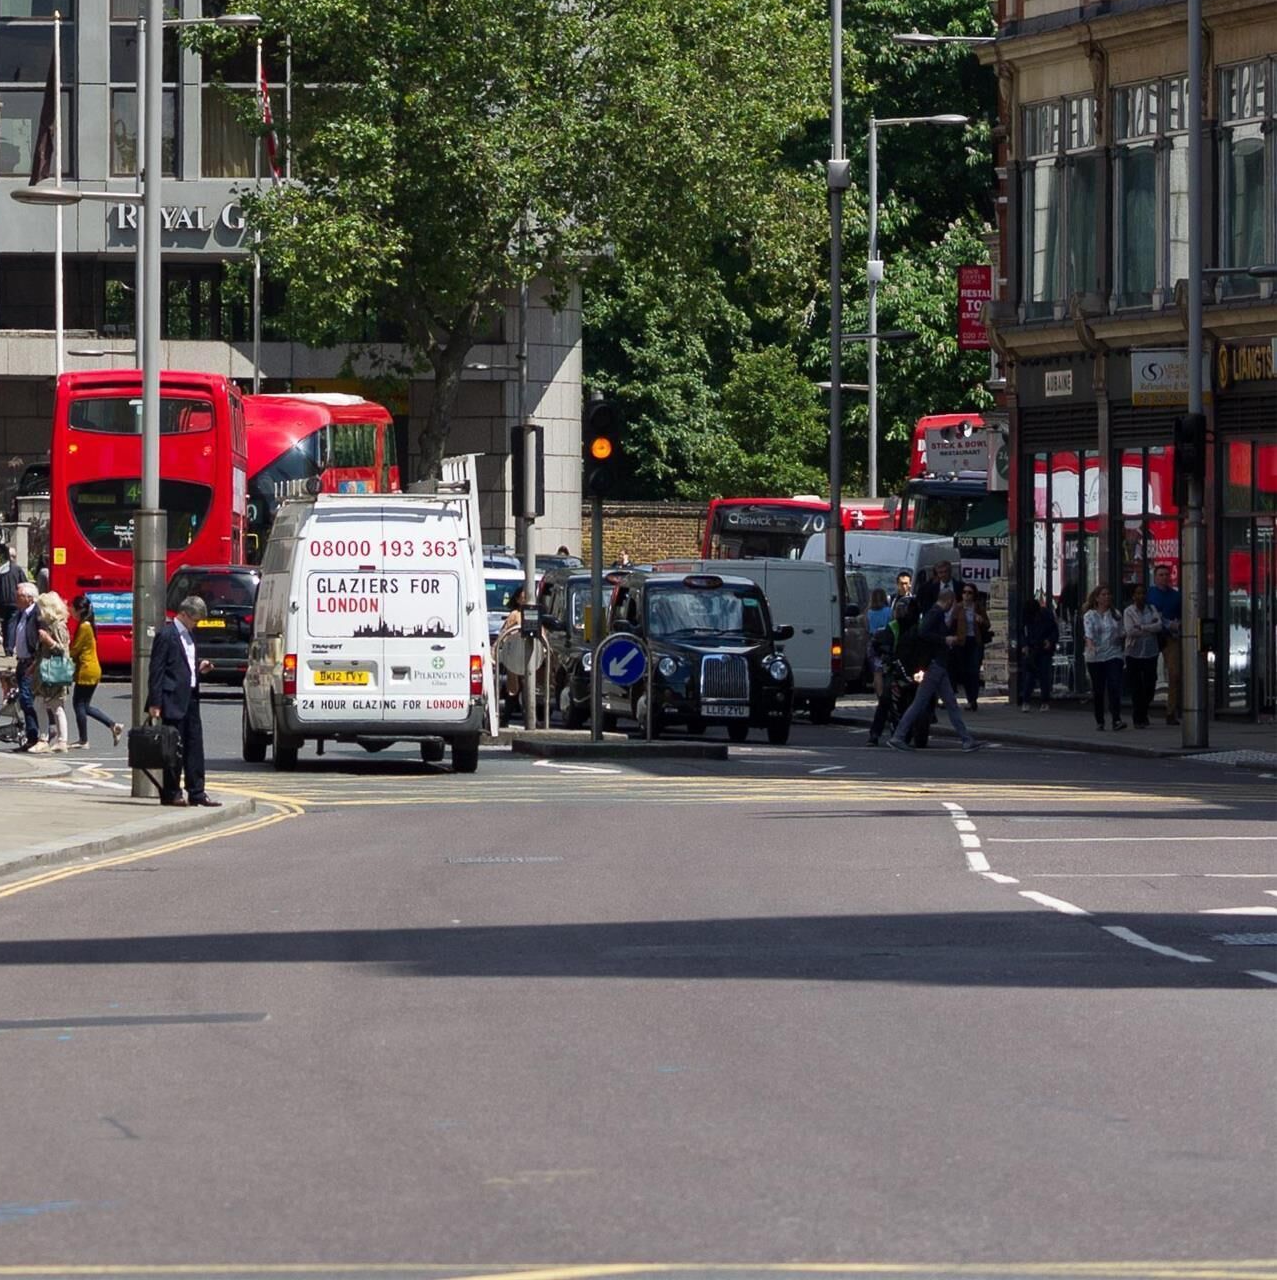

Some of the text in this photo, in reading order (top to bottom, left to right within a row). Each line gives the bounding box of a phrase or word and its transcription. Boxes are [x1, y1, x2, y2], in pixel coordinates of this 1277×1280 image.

[117, 203, 215, 230] RYAL
[931, 441, 954, 450] STICK
[939, 449, 980, 457] RESTAURANT
[728, 512, 771, 526] Chiswick
[802, 514, 825, 532] 70
[958, 537, 973, 546] FOOD
[310, 540, 457, 557] 08000 193 363
[317, 578, 440, 594] GLAZIERS FOR
[317, 597, 379, 613] LONDON
[414, 670, 465, 680] PILKINGTON
[302, 699, 465, 710] 24 HOUR GLAZING FOR LONDON
